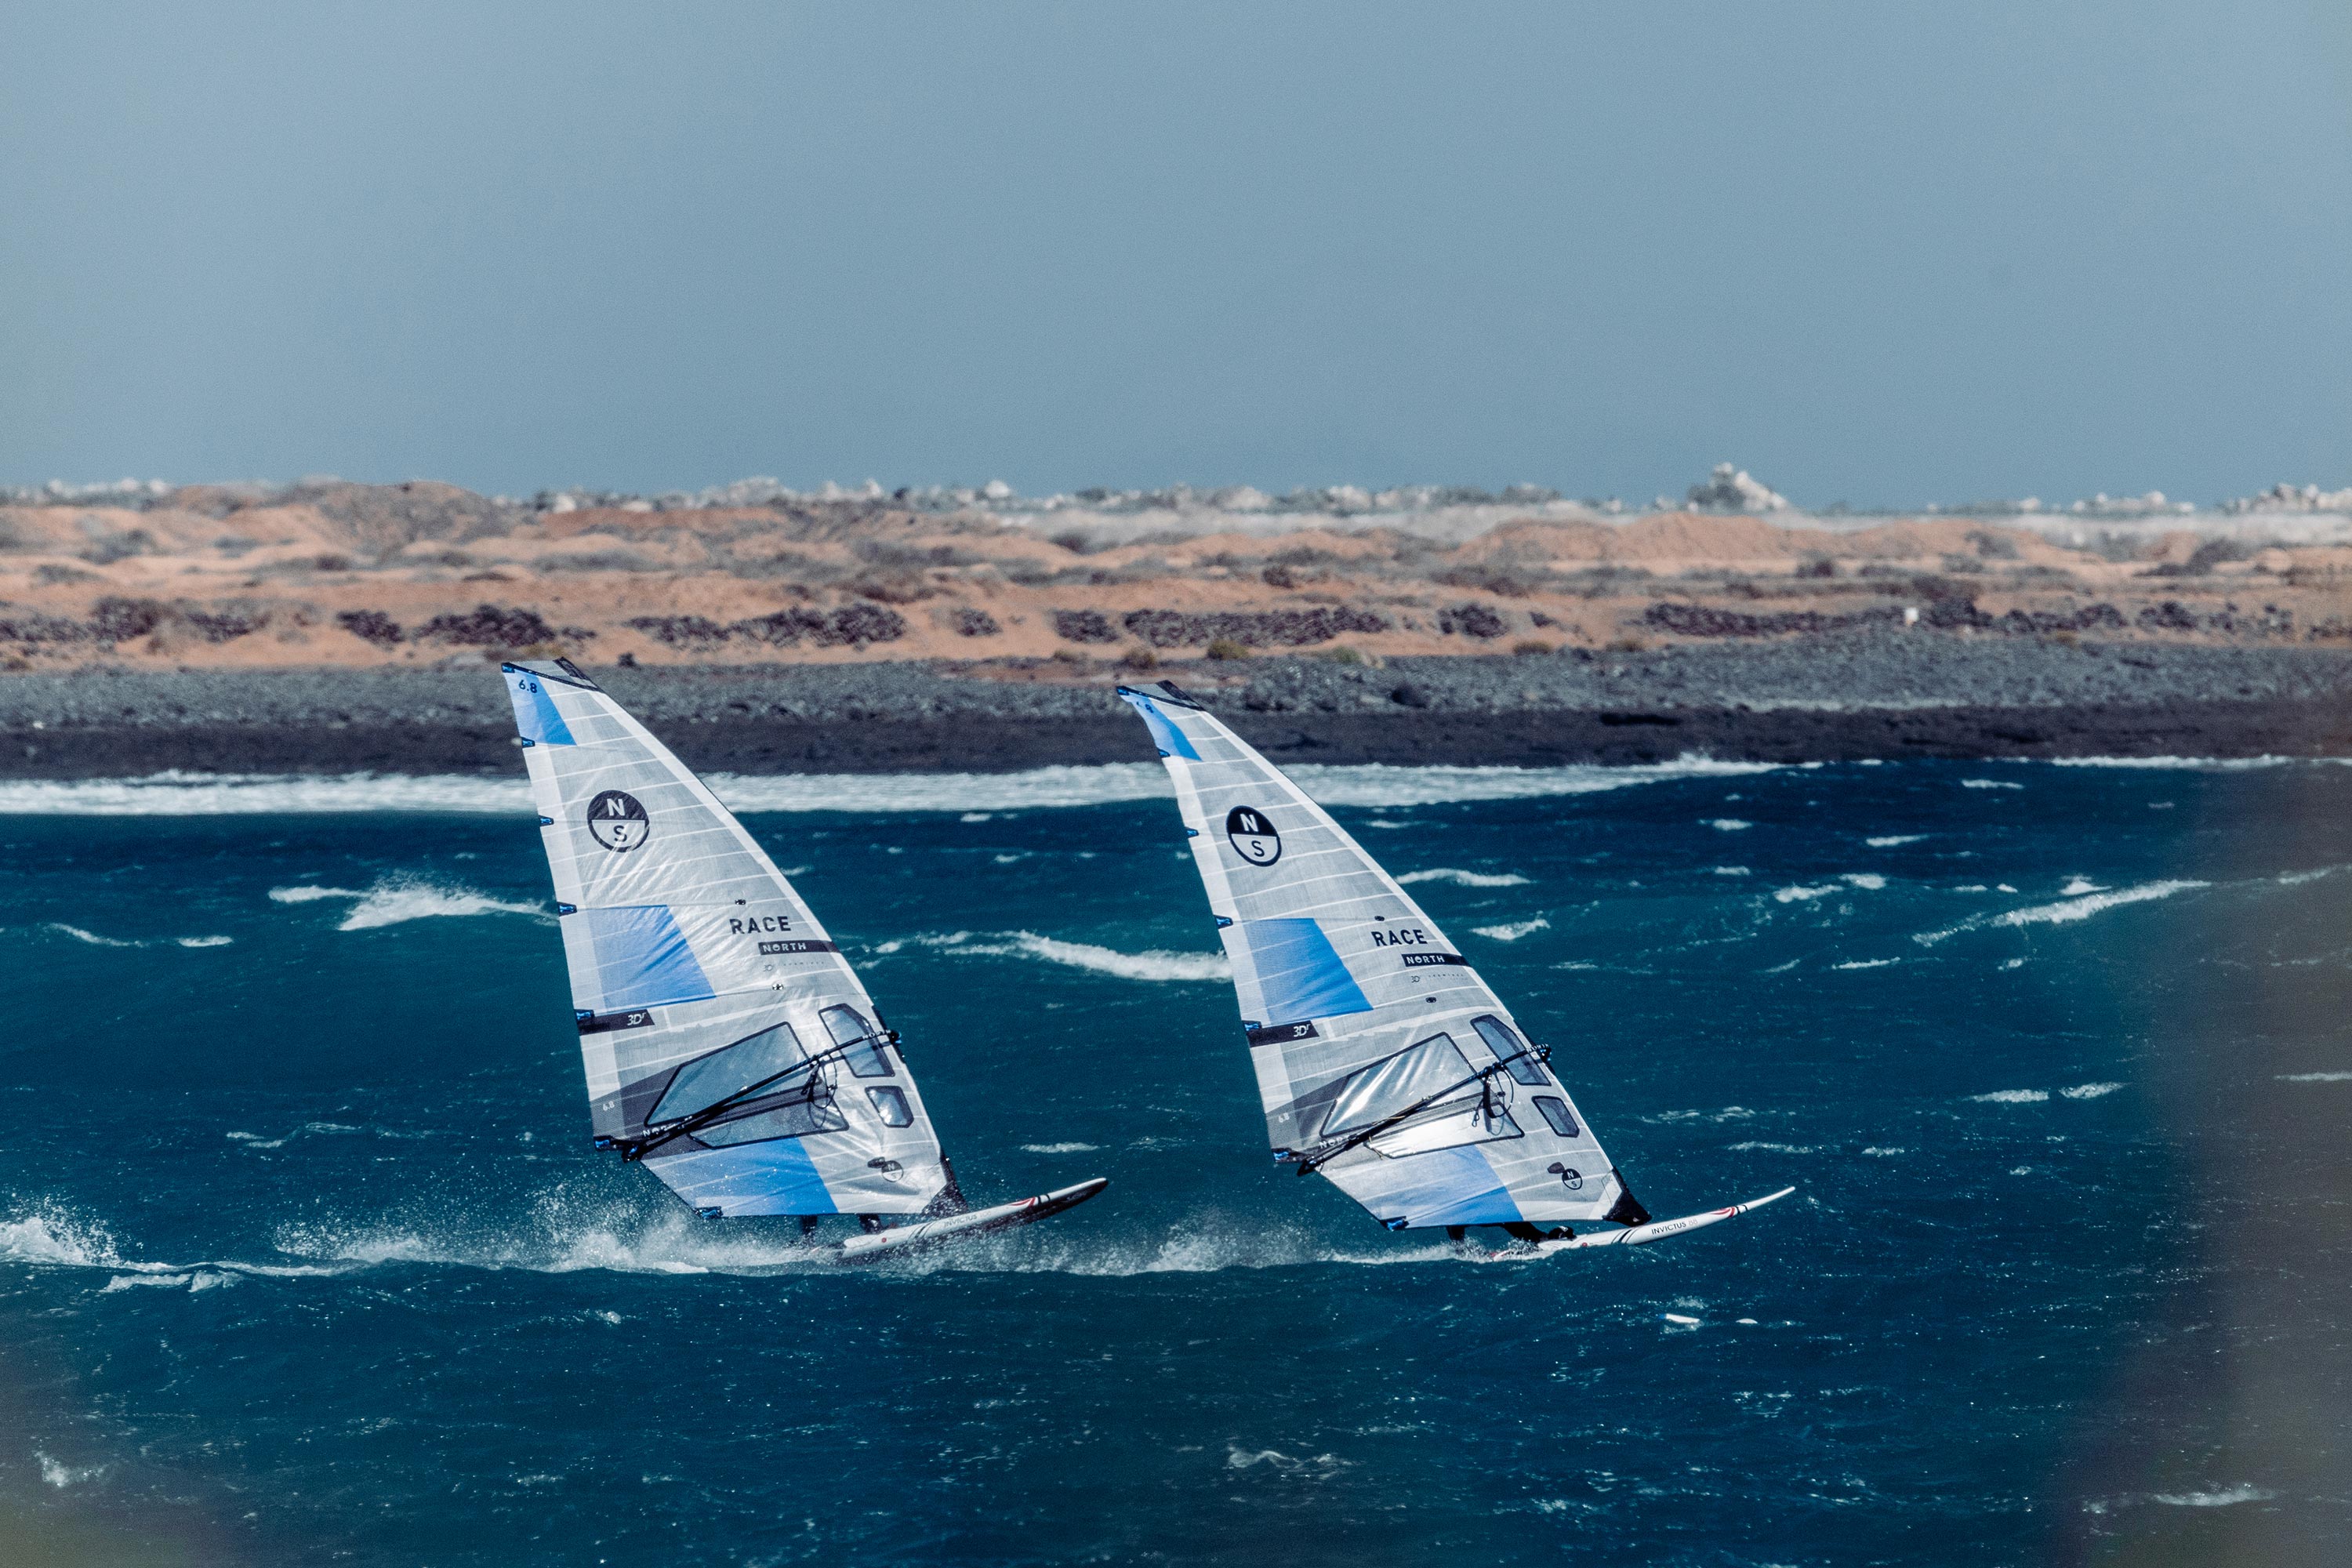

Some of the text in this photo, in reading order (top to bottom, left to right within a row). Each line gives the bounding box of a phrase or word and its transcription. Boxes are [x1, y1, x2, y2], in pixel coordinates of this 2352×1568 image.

[518, 679, 538, 694] 6.8
[606, 798, 626, 816] N
[1240, 813, 1259, 832] N
[613, 825, 627, 842] S
[1251, 840, 1265, 857] S
[729, 916, 792, 935] RACE
[1370, 929, 1428, 946] RACE
[762, 942, 807, 953] NORTH
[1406, 955, 1445, 964] NORTH
[602, 1101, 615, 1112] 6.8
[1651, 1221, 1686, 1235] INVICTUS
